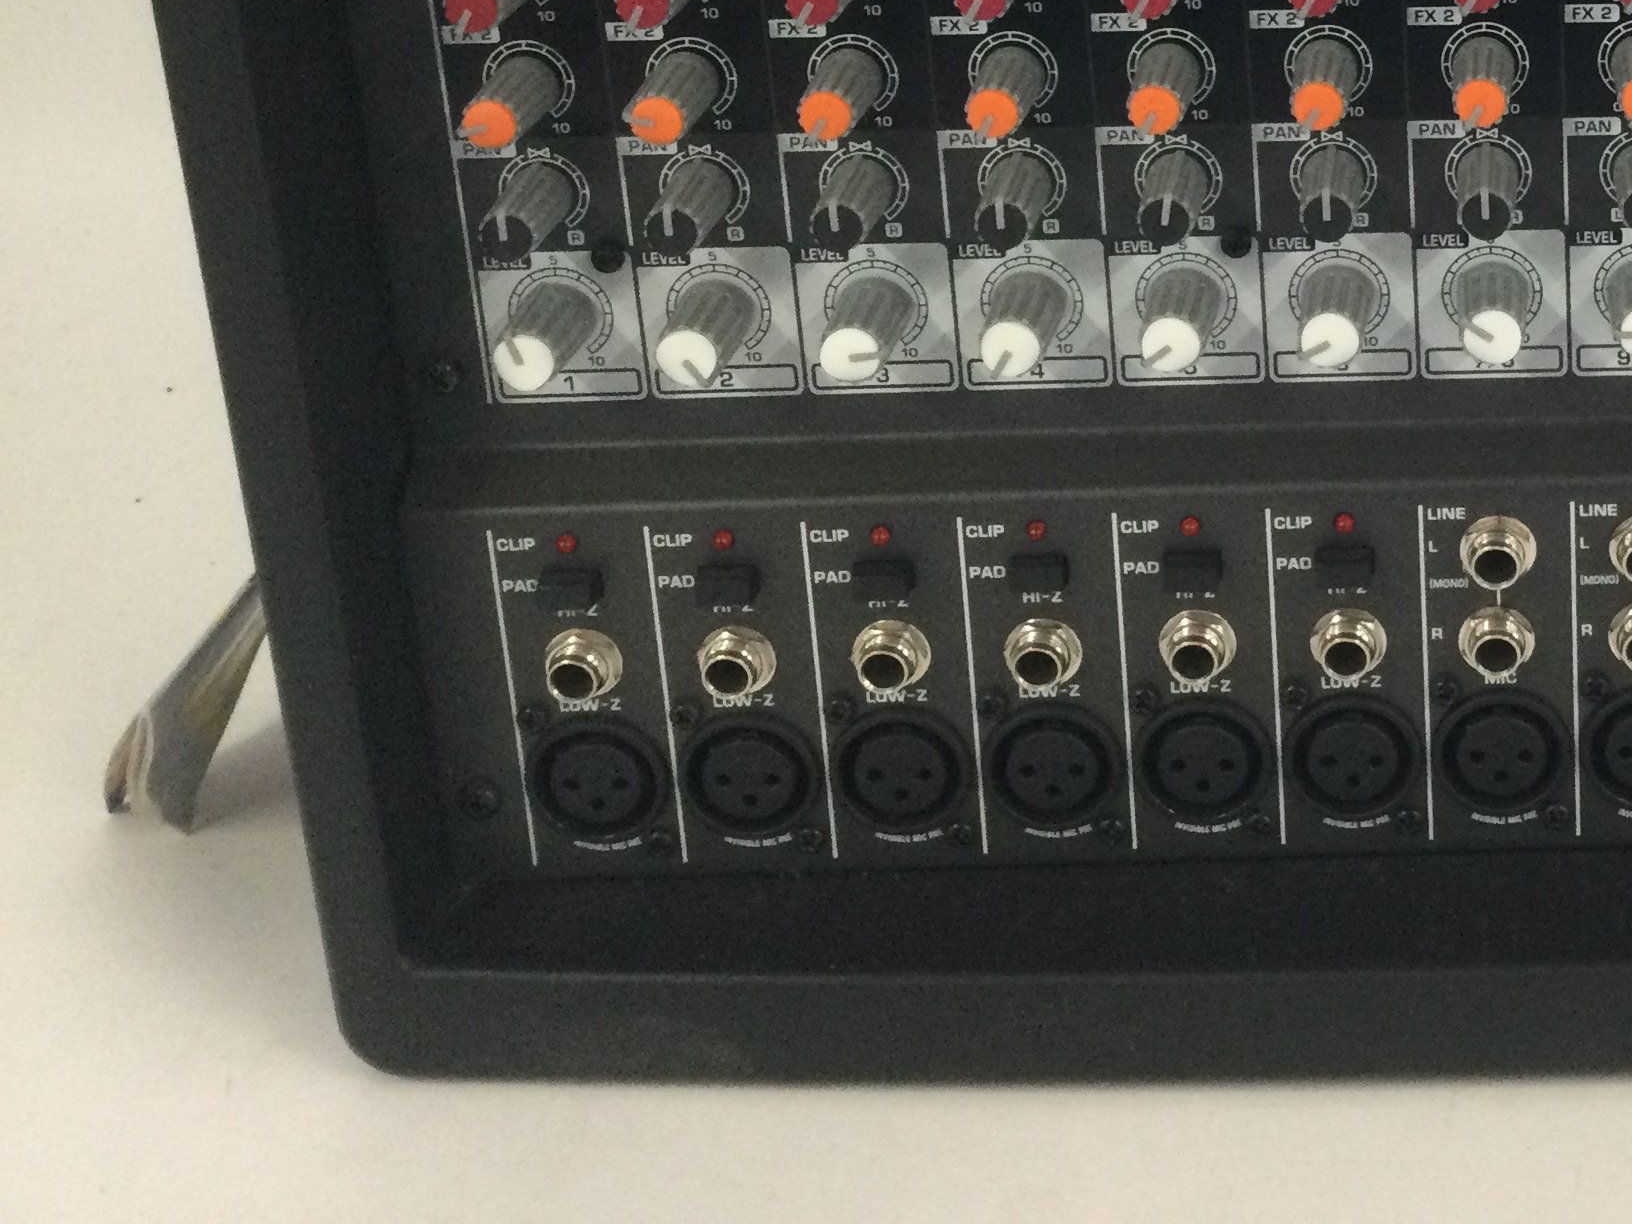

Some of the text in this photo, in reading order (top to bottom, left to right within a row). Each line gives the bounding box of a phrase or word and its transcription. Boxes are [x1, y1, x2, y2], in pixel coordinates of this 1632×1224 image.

[1572, 7, 1611, 21] FX 2
[1575, 120, 1611, 134] PAN
[1422, 233, 1464, 247] LEVEL
[1576, 230, 1617, 243] LEVEL
[1428, 507, 1466, 520] LINE
[1580, 504, 1618, 517] LINE
[966, 525, 1005, 538] CLIP
[969, 565, 1006, 579] PAD
[1022, 590, 1063, 604] HI-Z
[1018, 683, 1080, 698] LOW-Z
